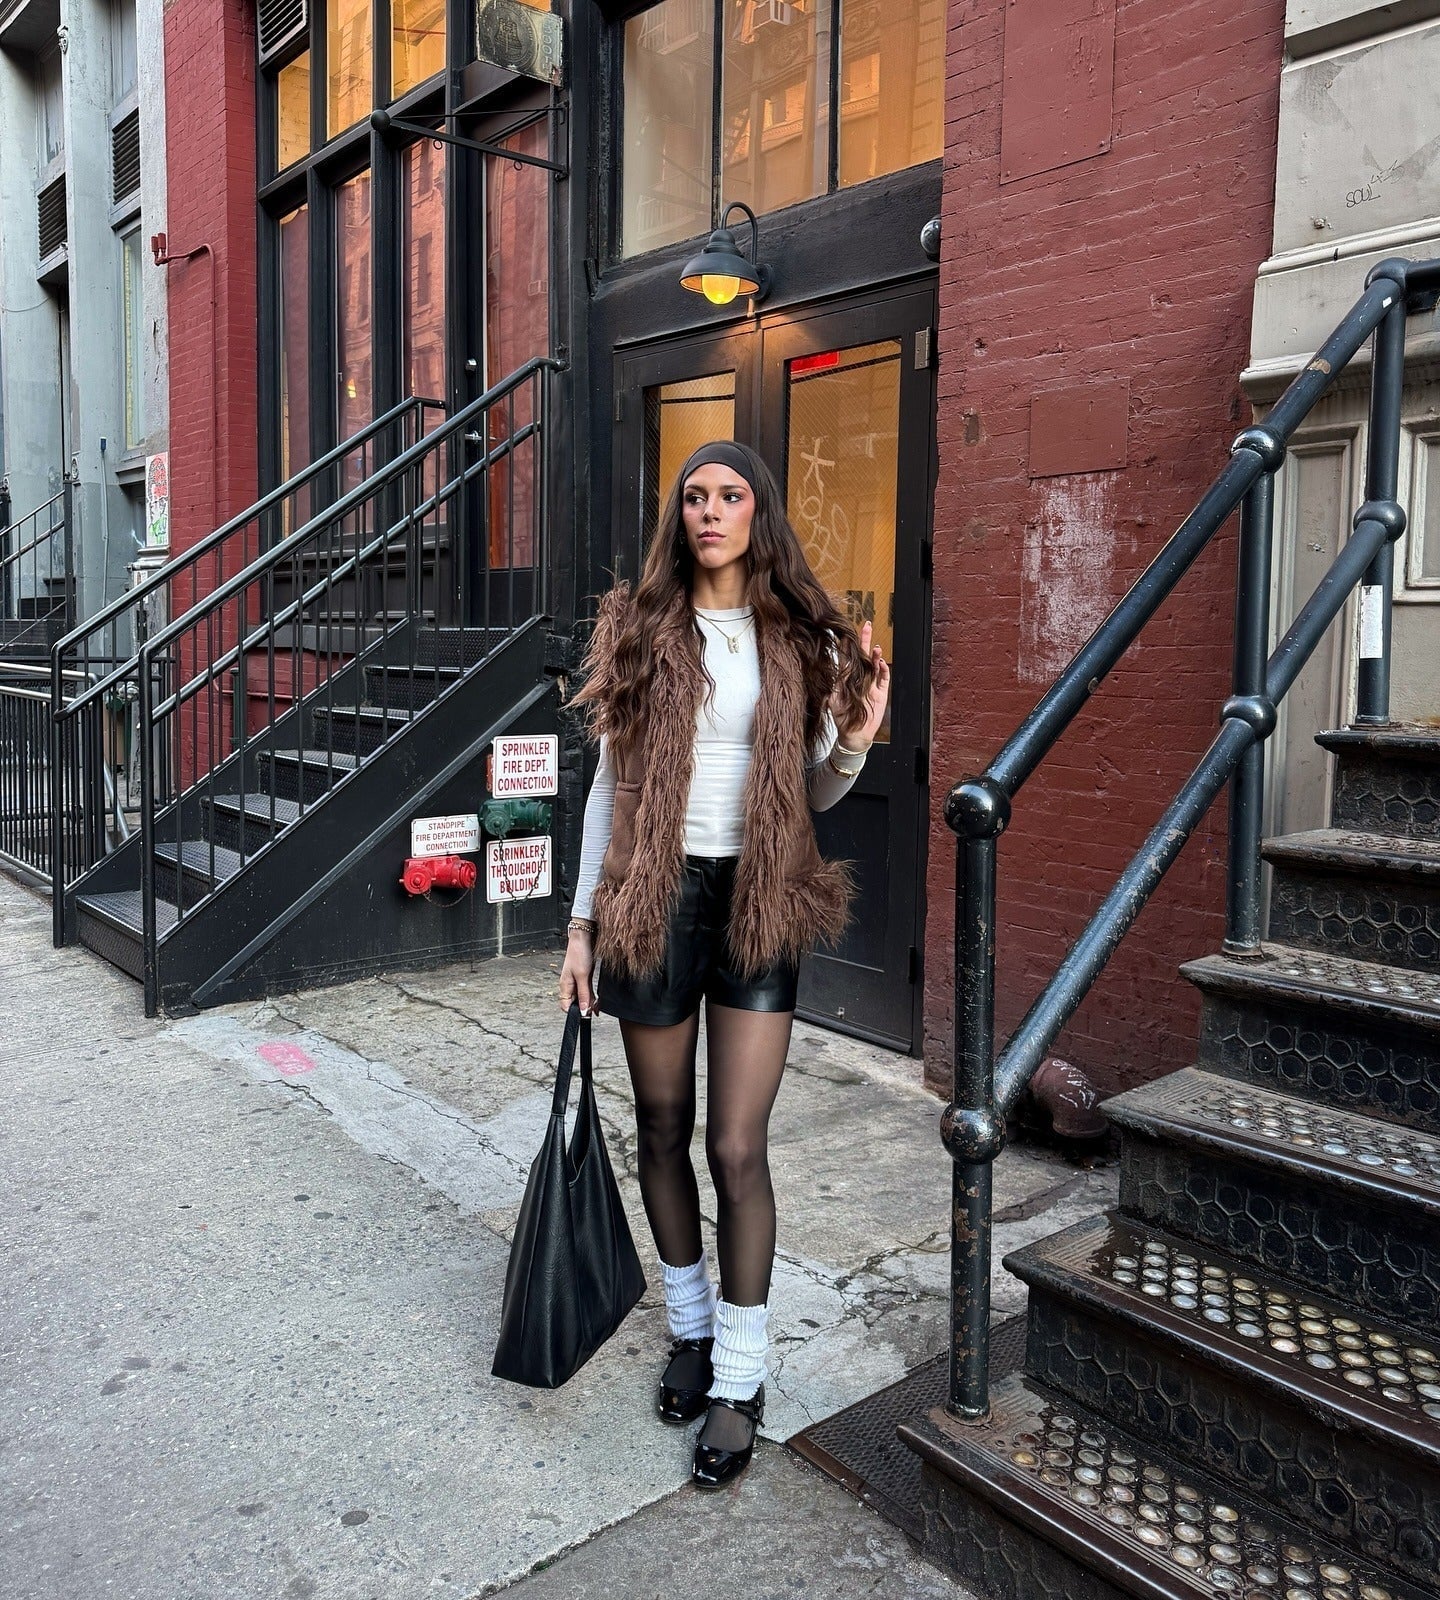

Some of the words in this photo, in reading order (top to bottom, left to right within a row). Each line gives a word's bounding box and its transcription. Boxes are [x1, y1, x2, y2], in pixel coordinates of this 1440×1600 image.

[502, 742, 550, 756] SPRINKLER
[503, 760, 522, 774] FIRE
[525, 759, 549, 773] DEPT.
[498, 776, 553, 791] CONNECTION
[428, 820, 465, 831] STANDPIPE
[415, 834, 431, 842] FIRE
[432, 829, 477, 841] DEPARTMENT
[426, 840, 468, 851] CONNECTION
[493, 844, 546, 862] SPRINKLERS
[491, 860, 547, 878] THROUGHOUT
[500, 877, 539, 894] BUILDING
